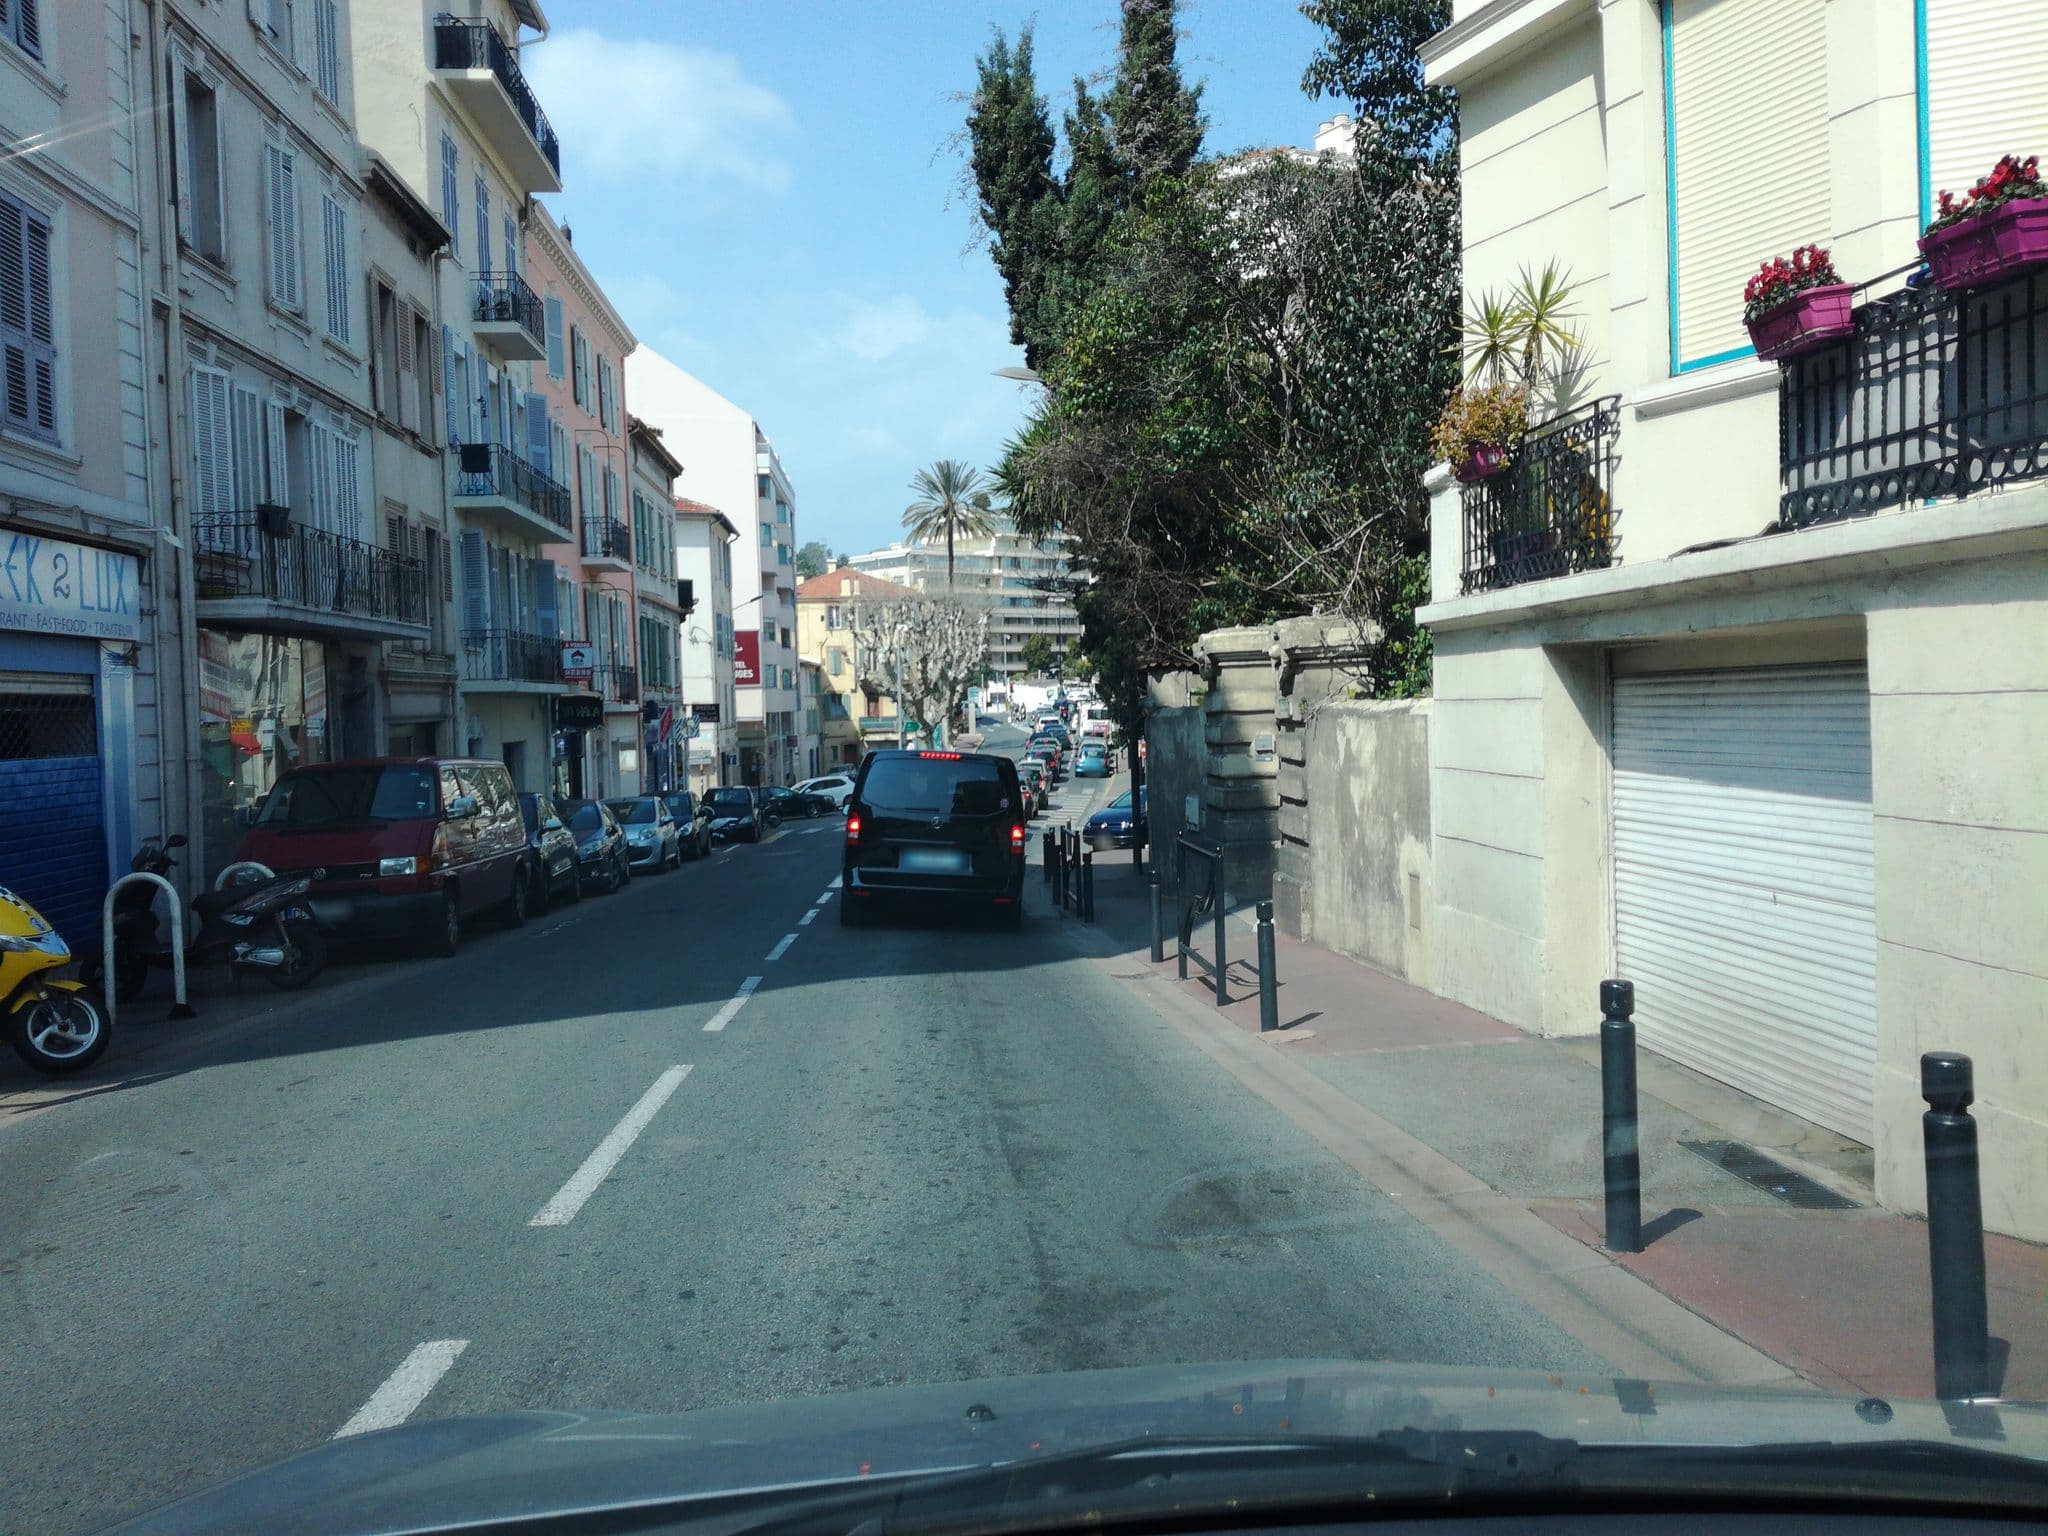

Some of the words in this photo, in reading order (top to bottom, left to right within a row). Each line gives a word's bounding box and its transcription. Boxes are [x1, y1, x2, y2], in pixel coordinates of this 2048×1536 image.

[0, 535, 43, 605] EK
[53, 552, 71, 600] 2
[78, 547, 128, 615] LUX
[36, 612, 87, 634] FAST-FOOD
